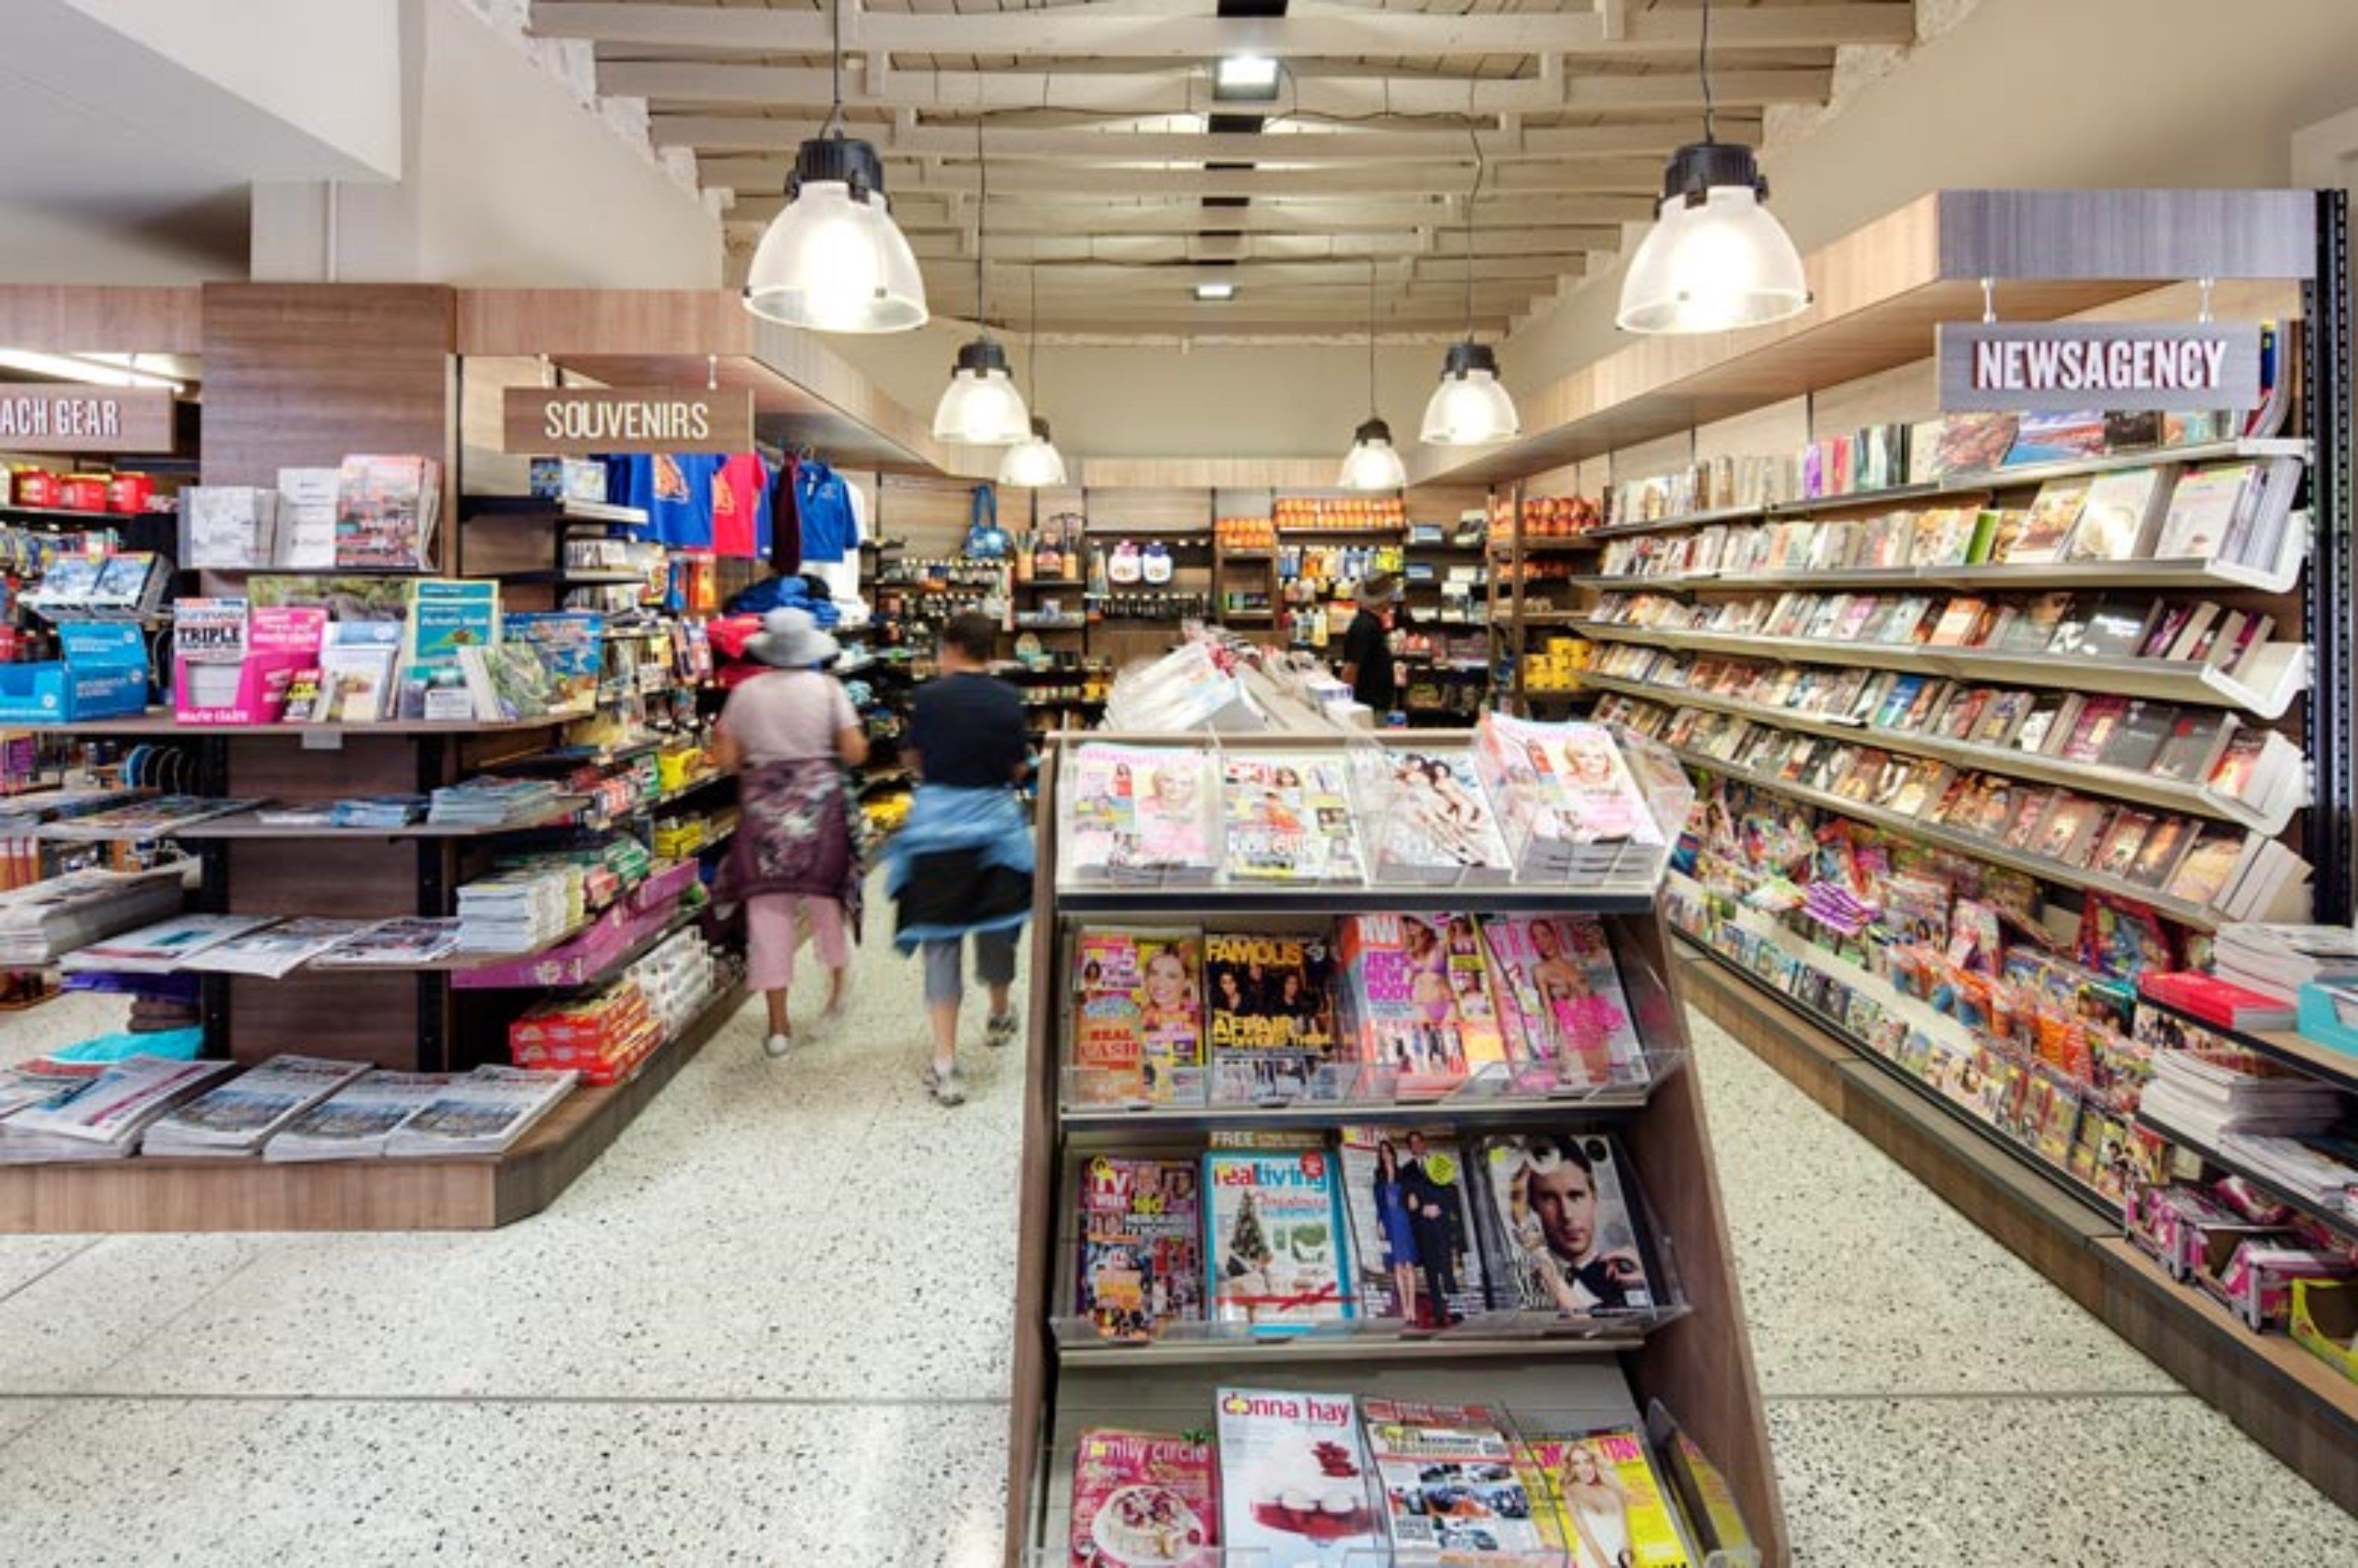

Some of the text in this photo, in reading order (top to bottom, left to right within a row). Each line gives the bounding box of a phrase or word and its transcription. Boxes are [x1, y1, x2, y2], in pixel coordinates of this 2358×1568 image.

[1974, 340, 2226, 391] NEWSAGENCY
[56, 398, 120, 435] GEAR
[544, 401, 709, 439] SOUVENIRS
[179, 627, 241, 643] TRIPLE
[176, 708, 248, 724] marie claire
[1207, 935, 1302, 966] FAMOUS
[1368, 983, 1413, 1001] BODY
[1080, 1042, 1138, 1058] CASH
[1210, 1131, 1254, 1148] FREE
[1223, 1392, 1350, 1427] donna hay
[1080, 1438, 1144, 1463] fmily
